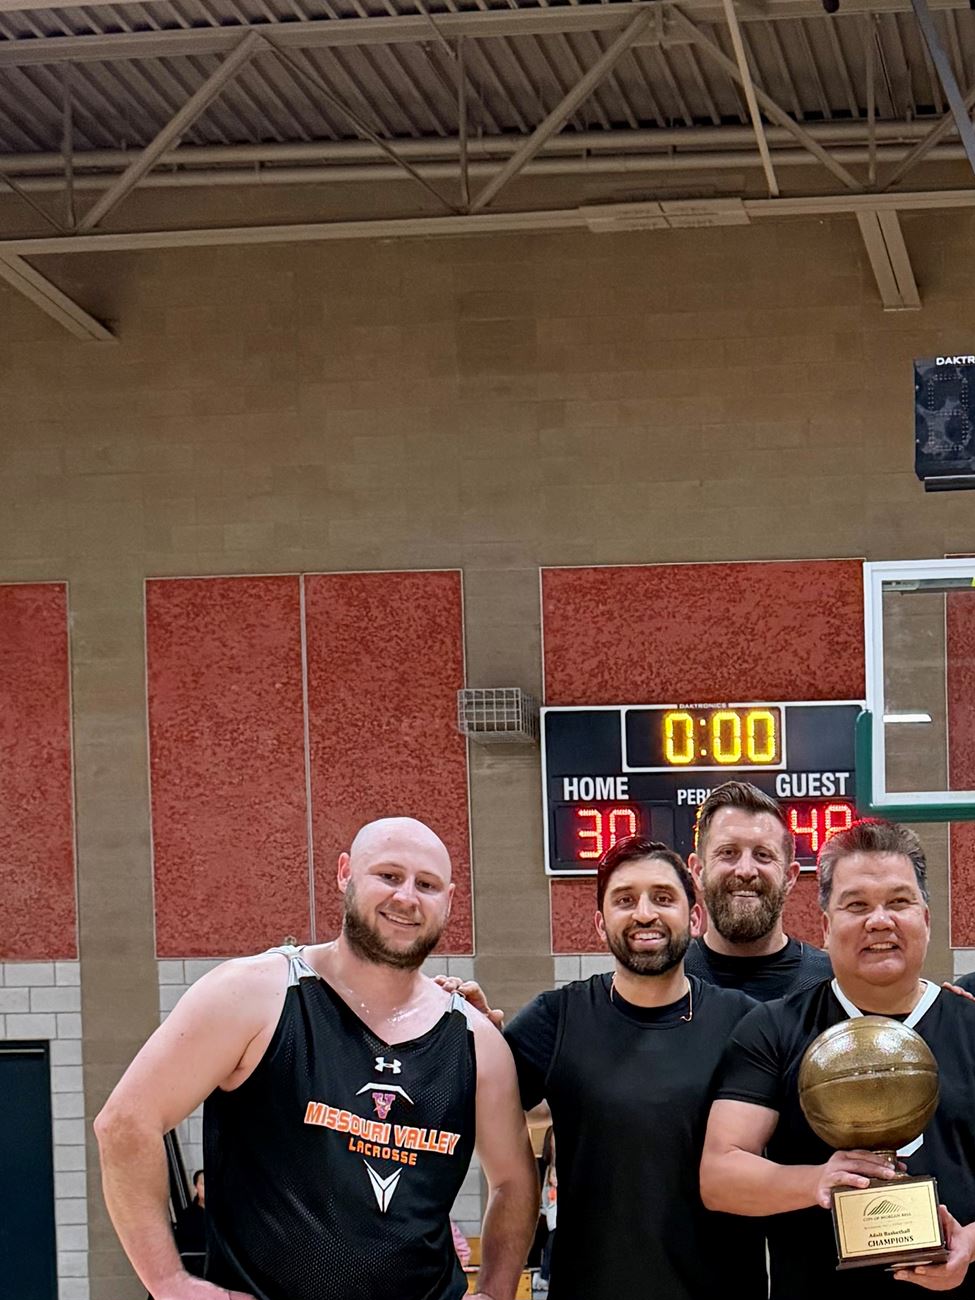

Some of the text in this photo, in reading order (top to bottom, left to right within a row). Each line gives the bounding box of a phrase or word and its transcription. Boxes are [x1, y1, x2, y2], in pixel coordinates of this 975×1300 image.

[666, 711, 775, 763] 0:00
[563, 777, 629, 801] HOME
[775, 772, 850, 797] GUEST
[304, 1101, 461, 1156] MISSOURI VALLEY
[348, 1137, 418, 1166] LACROSSE
[868, 1235, 914, 1247] CHAMPIONS
